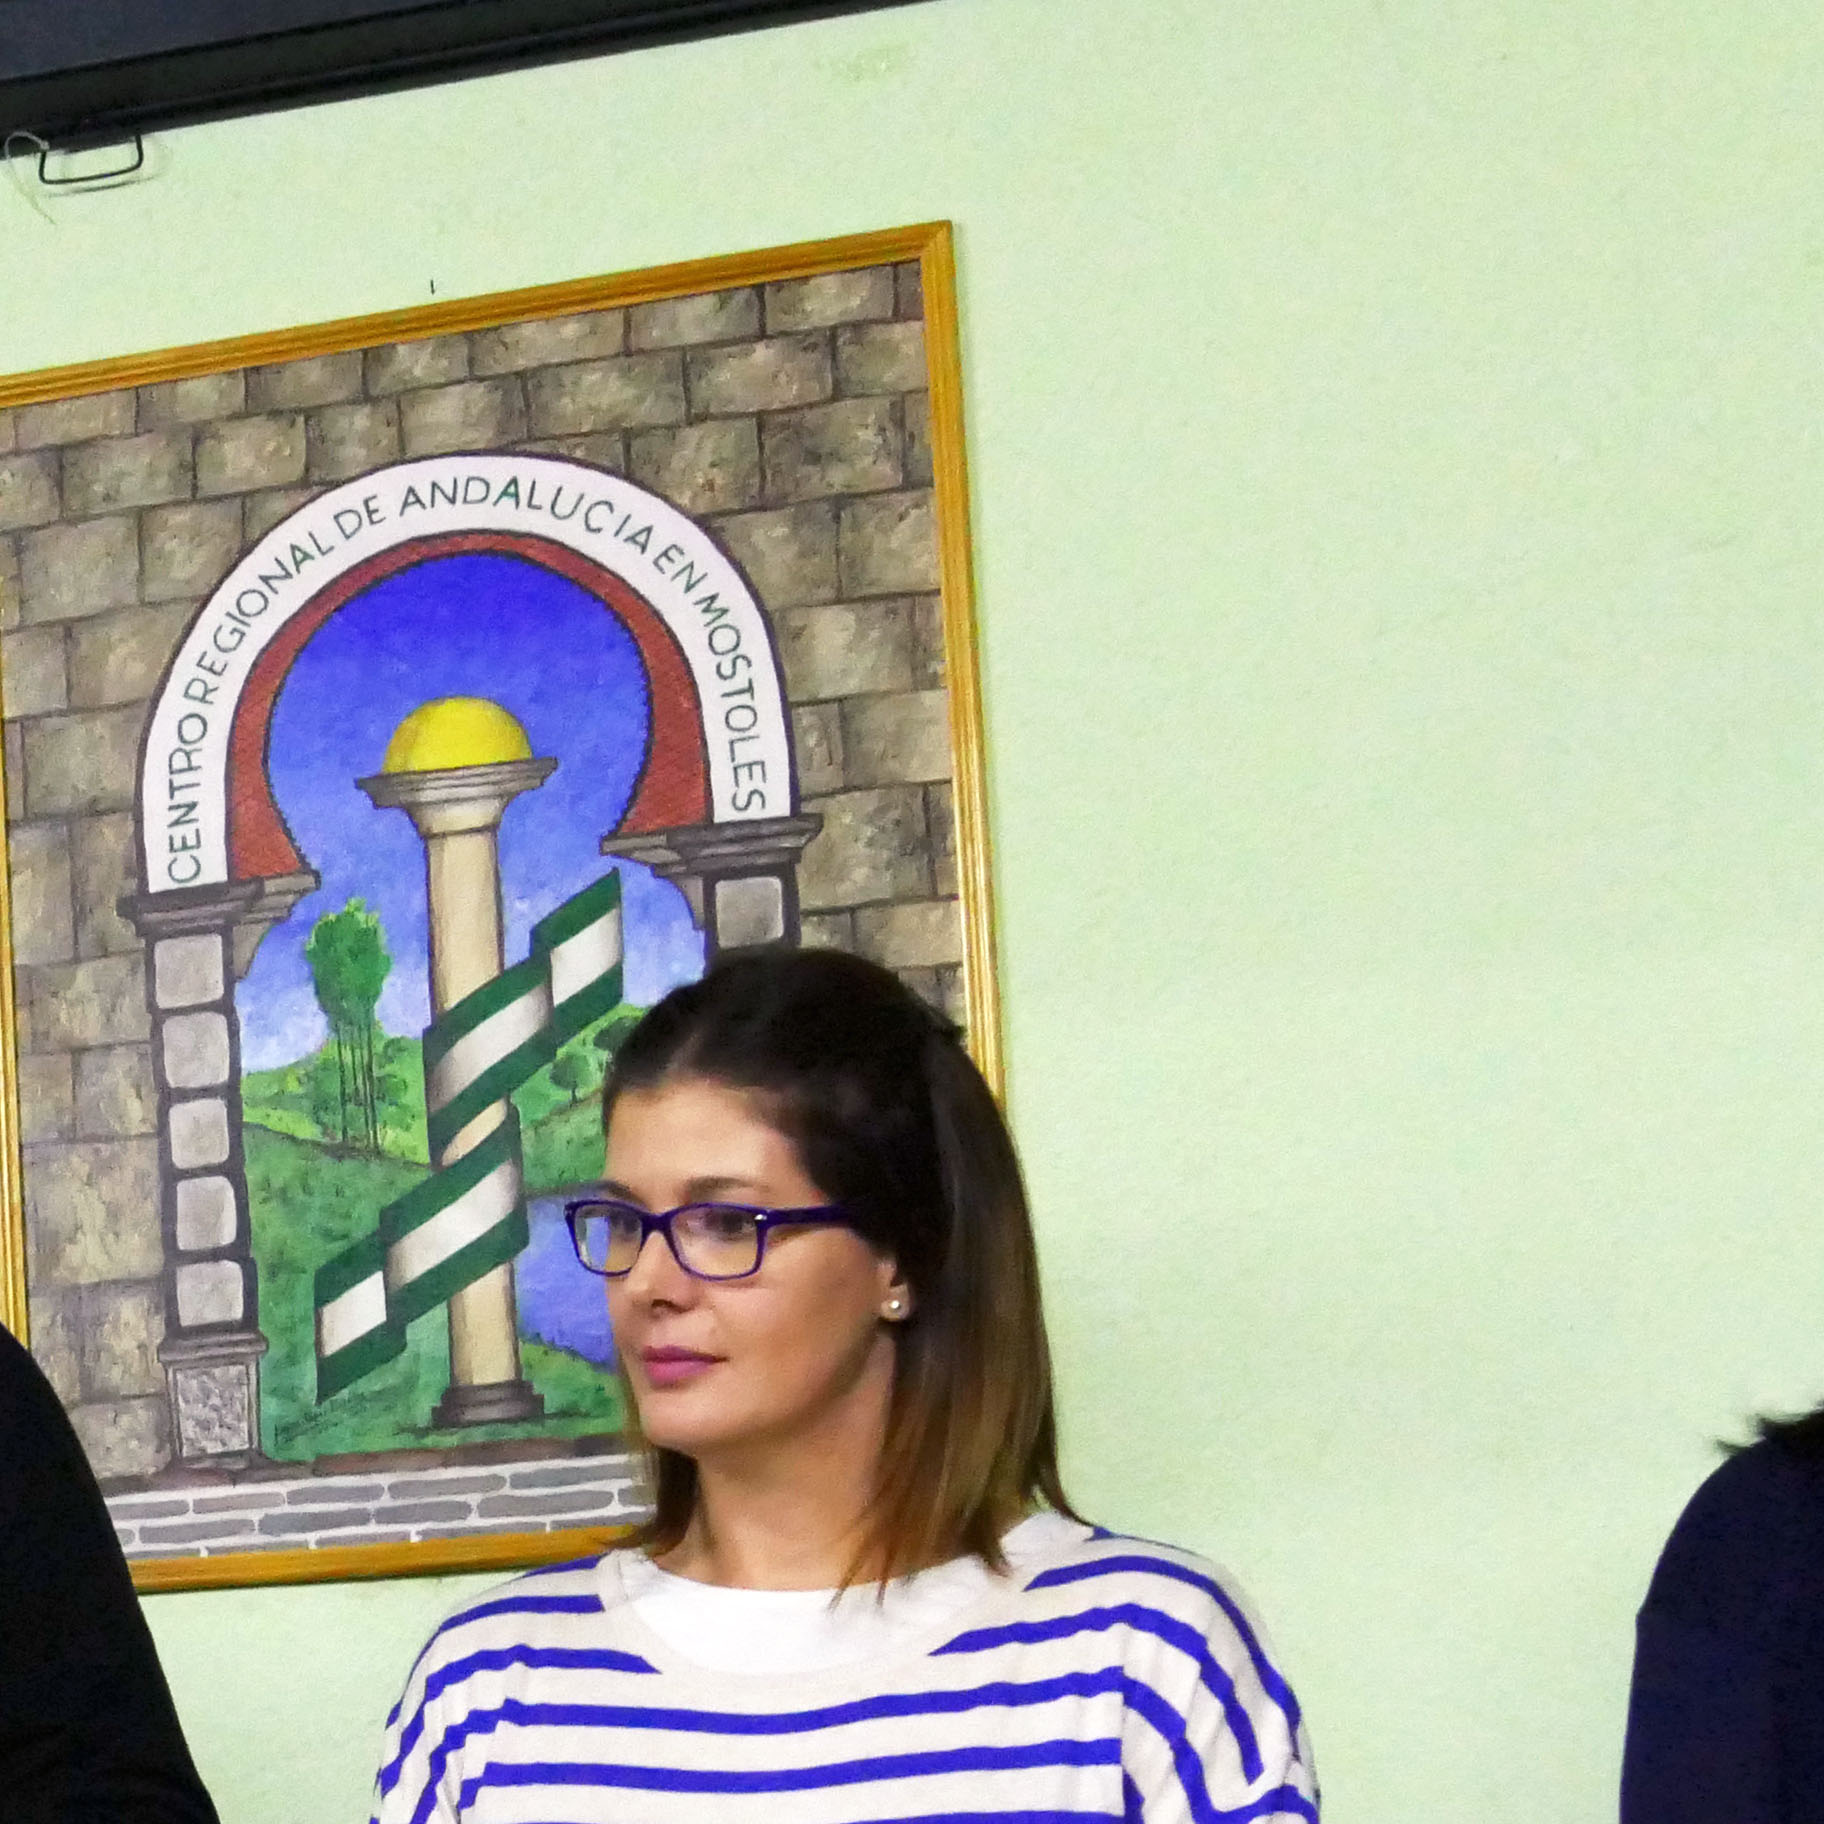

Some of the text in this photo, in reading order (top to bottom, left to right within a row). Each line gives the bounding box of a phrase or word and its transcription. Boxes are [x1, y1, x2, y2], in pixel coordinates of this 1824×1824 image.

[167, 475, 768, 885] CENTRO REGIONAL DE ANDALUCIA EN MOSTOLES
